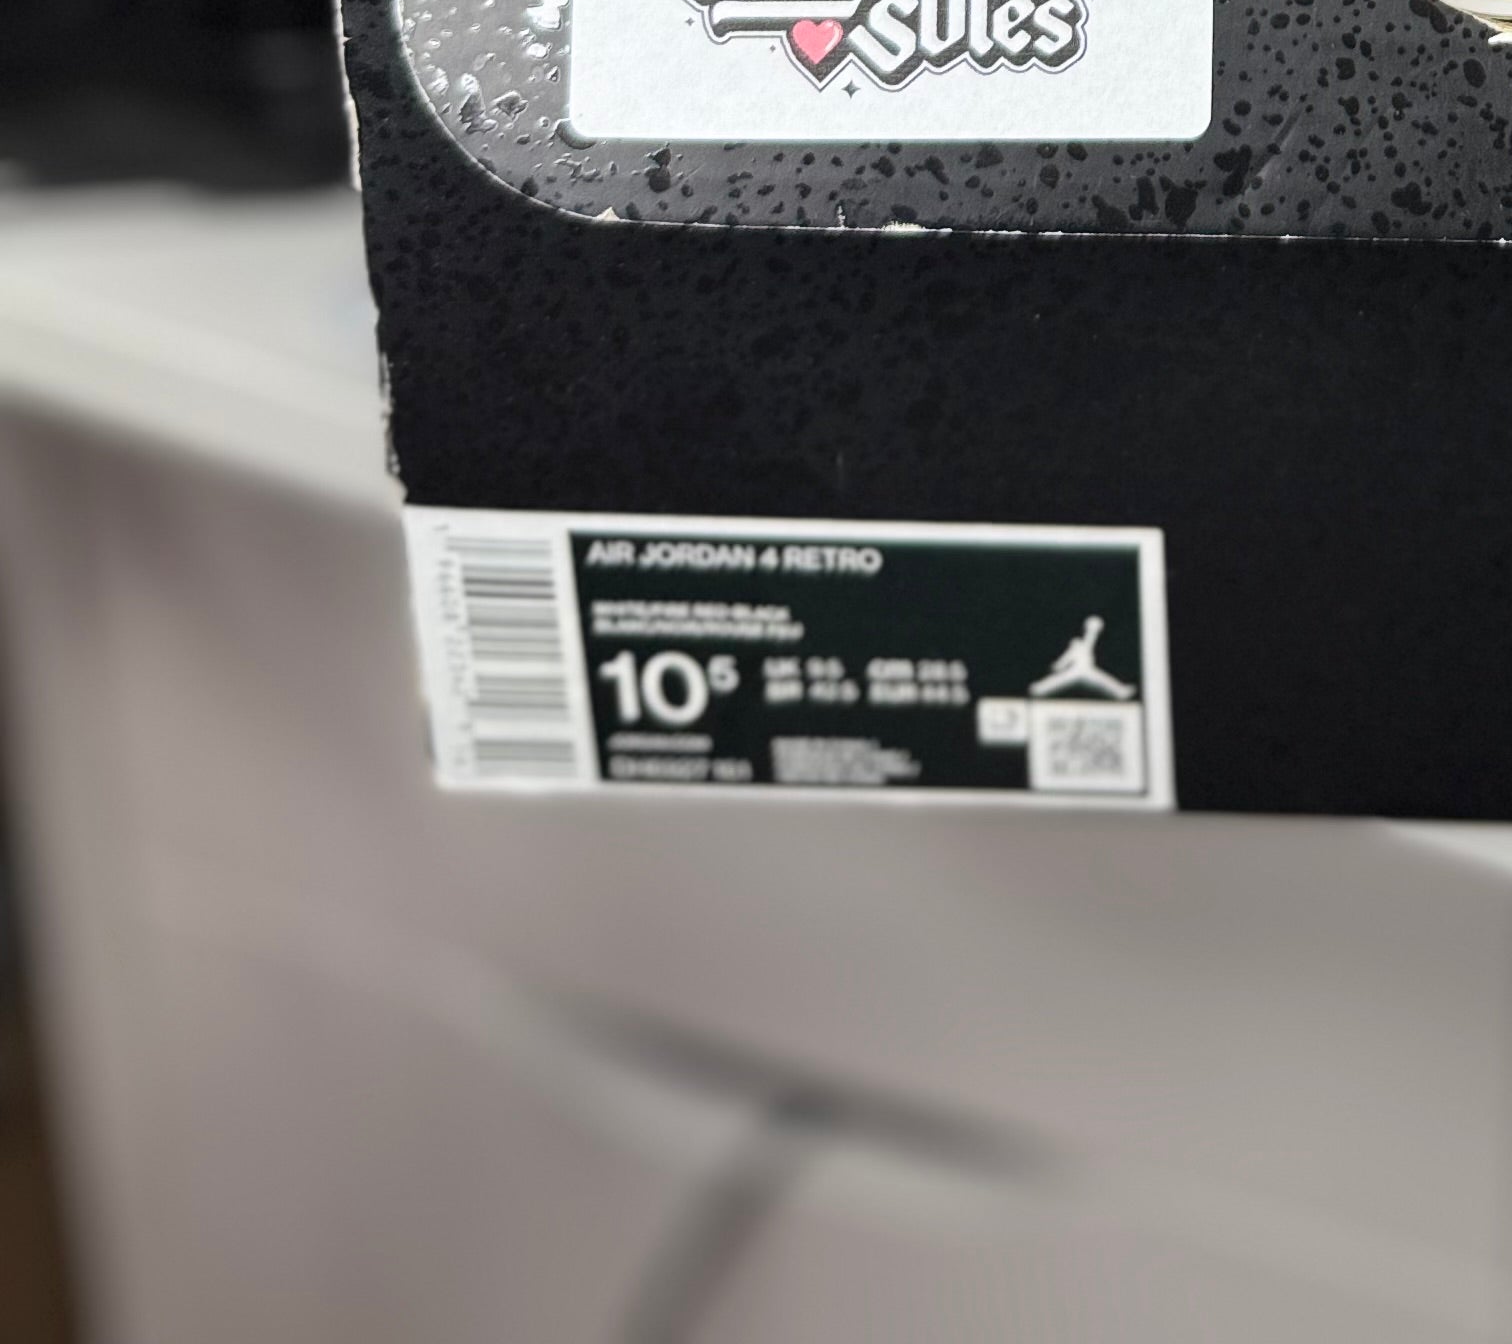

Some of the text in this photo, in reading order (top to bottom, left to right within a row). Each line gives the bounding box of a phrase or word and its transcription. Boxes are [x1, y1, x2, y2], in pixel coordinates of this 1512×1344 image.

[587, 540, 883, 574] AIR JORDAN 4 RETRO
